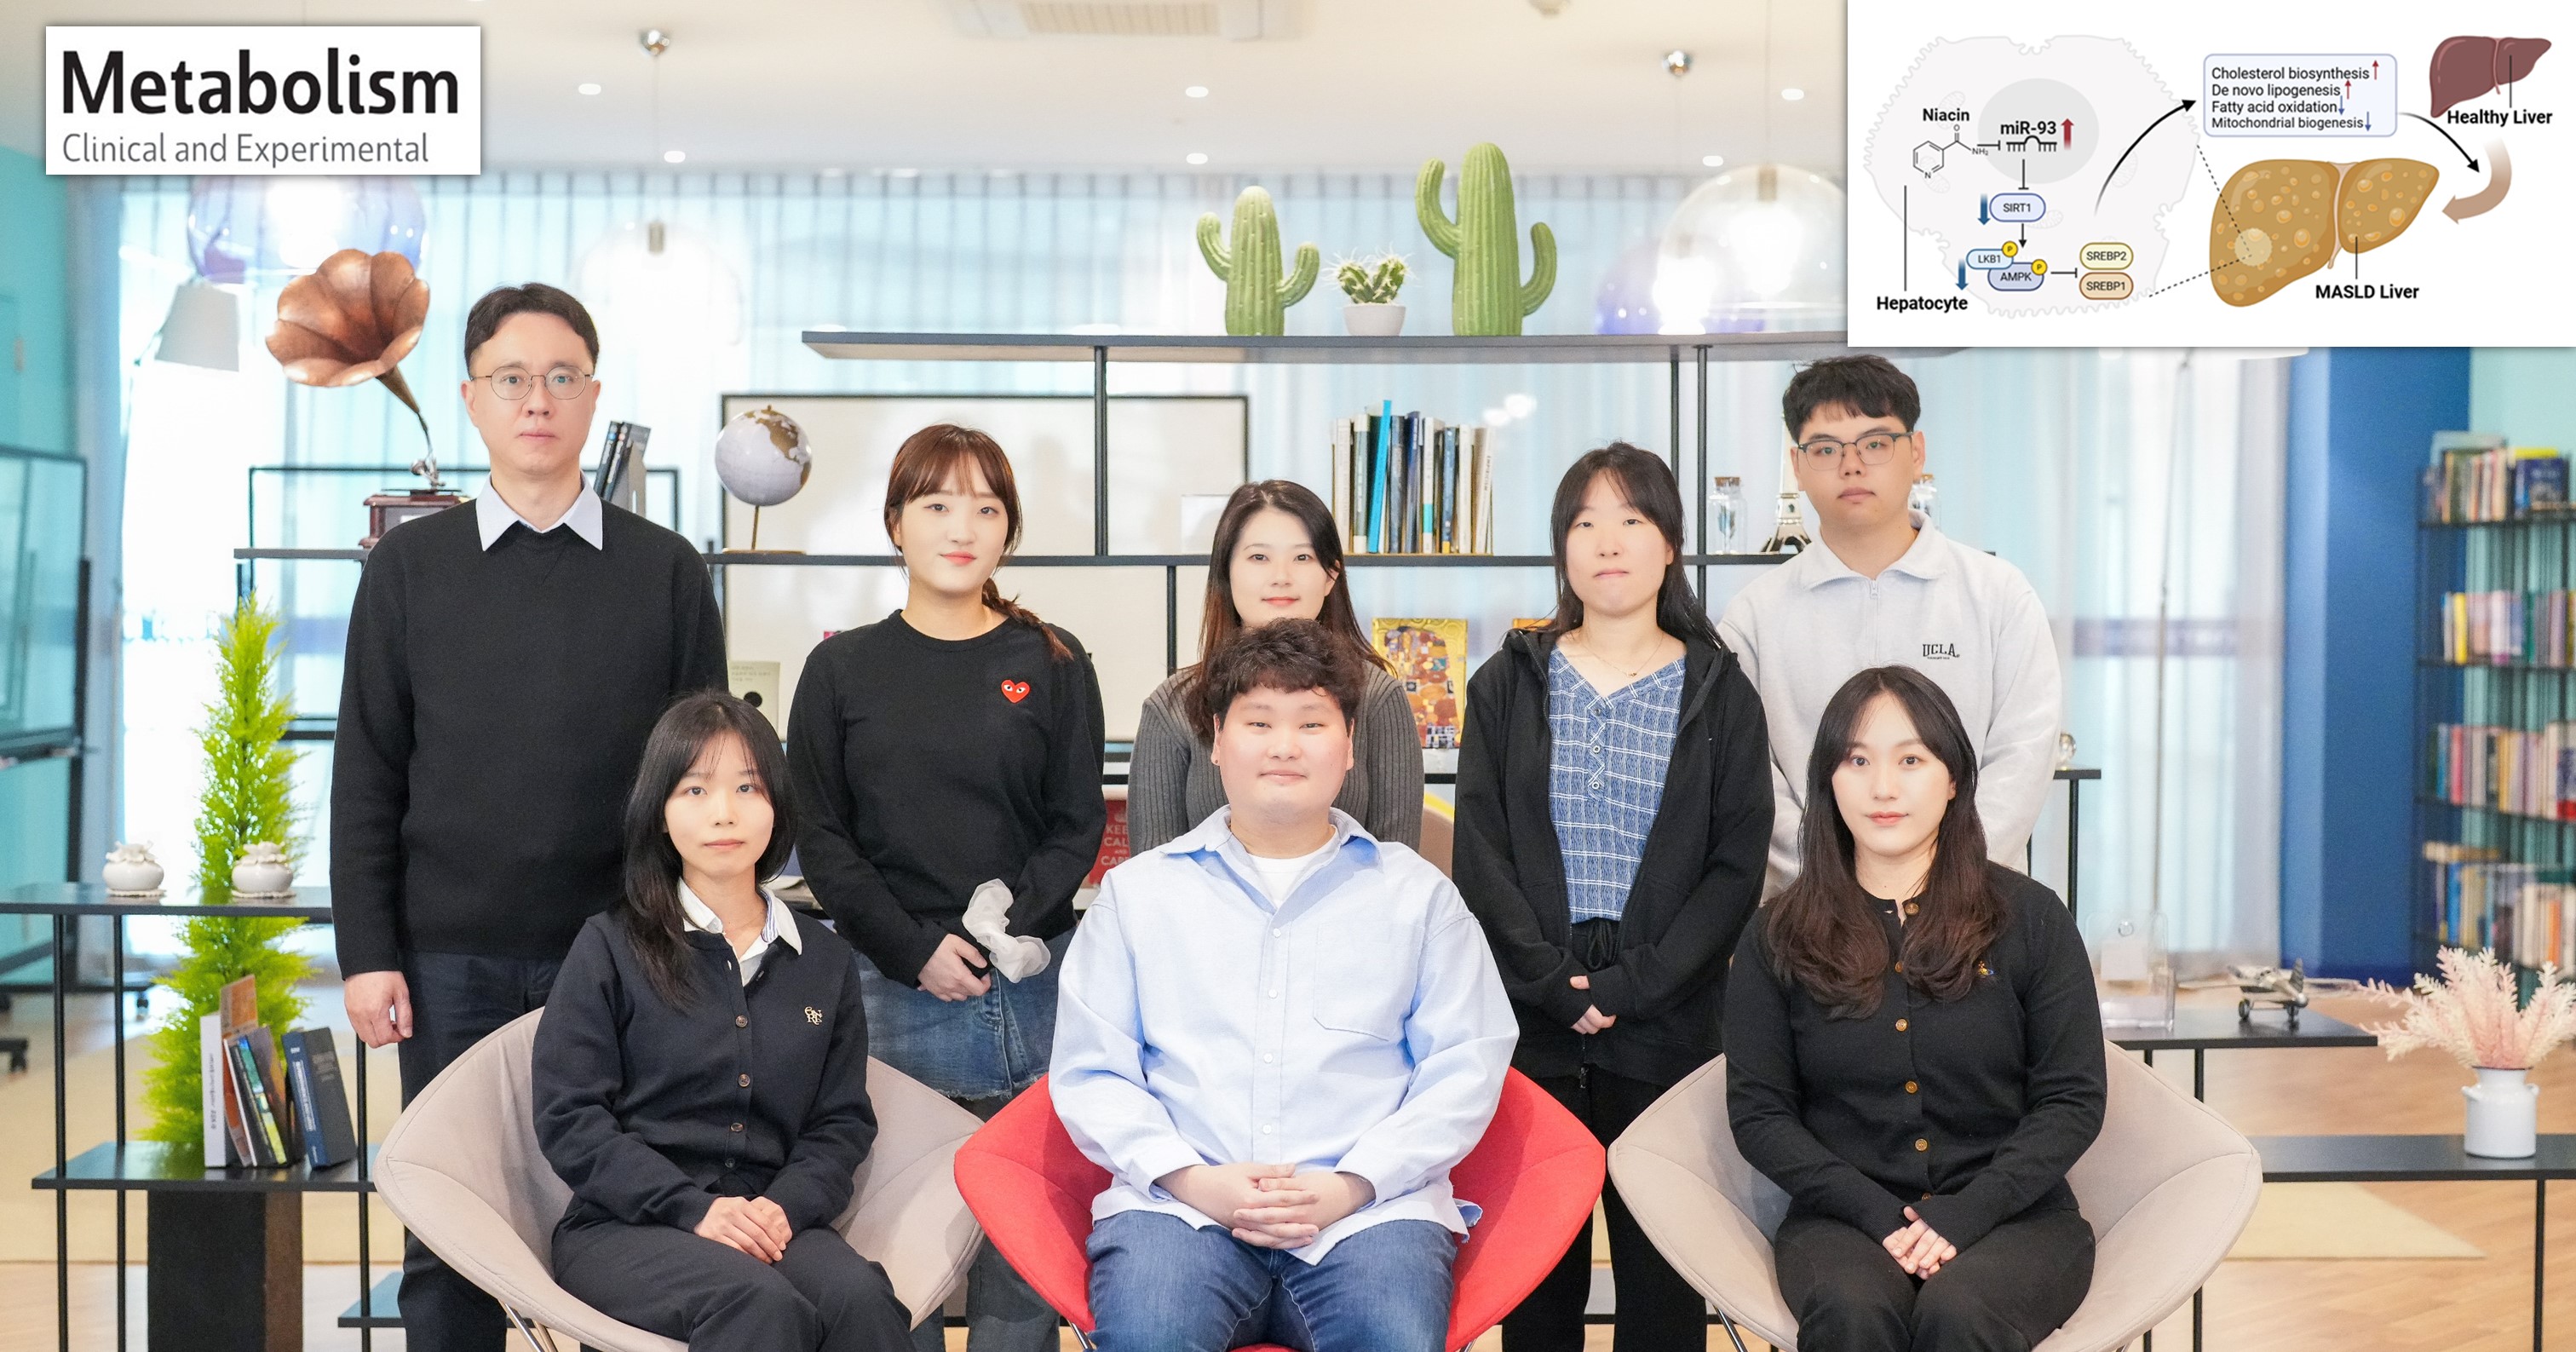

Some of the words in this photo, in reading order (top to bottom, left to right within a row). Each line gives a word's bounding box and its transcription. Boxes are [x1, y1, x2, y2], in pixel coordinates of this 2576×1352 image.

[1923, 643, 1956, 657] UCLA
[1106, 824, 1128, 835] KEE
[1104, 837, 1129, 847] CAL
